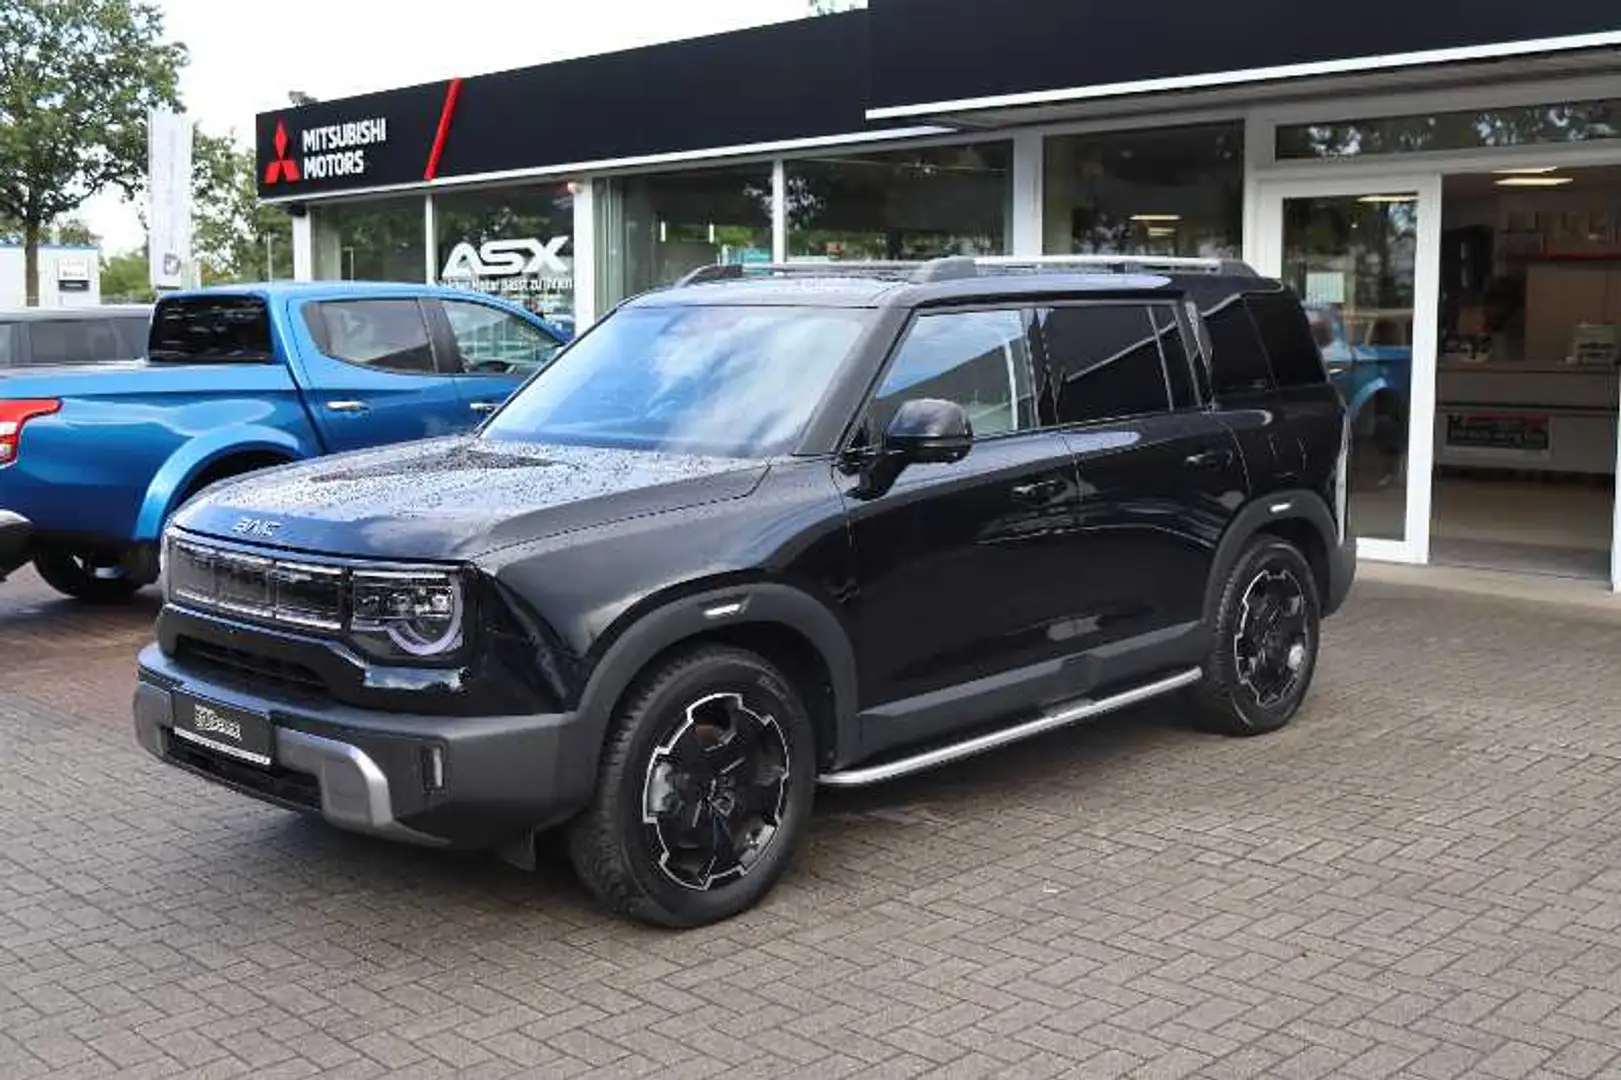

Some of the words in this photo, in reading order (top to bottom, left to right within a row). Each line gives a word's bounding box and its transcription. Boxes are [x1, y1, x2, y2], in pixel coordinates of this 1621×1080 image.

[302, 117, 387, 153] MITSUBISHI
[303, 150, 365, 180] MOTORS
[442, 235, 569, 278] ASX
